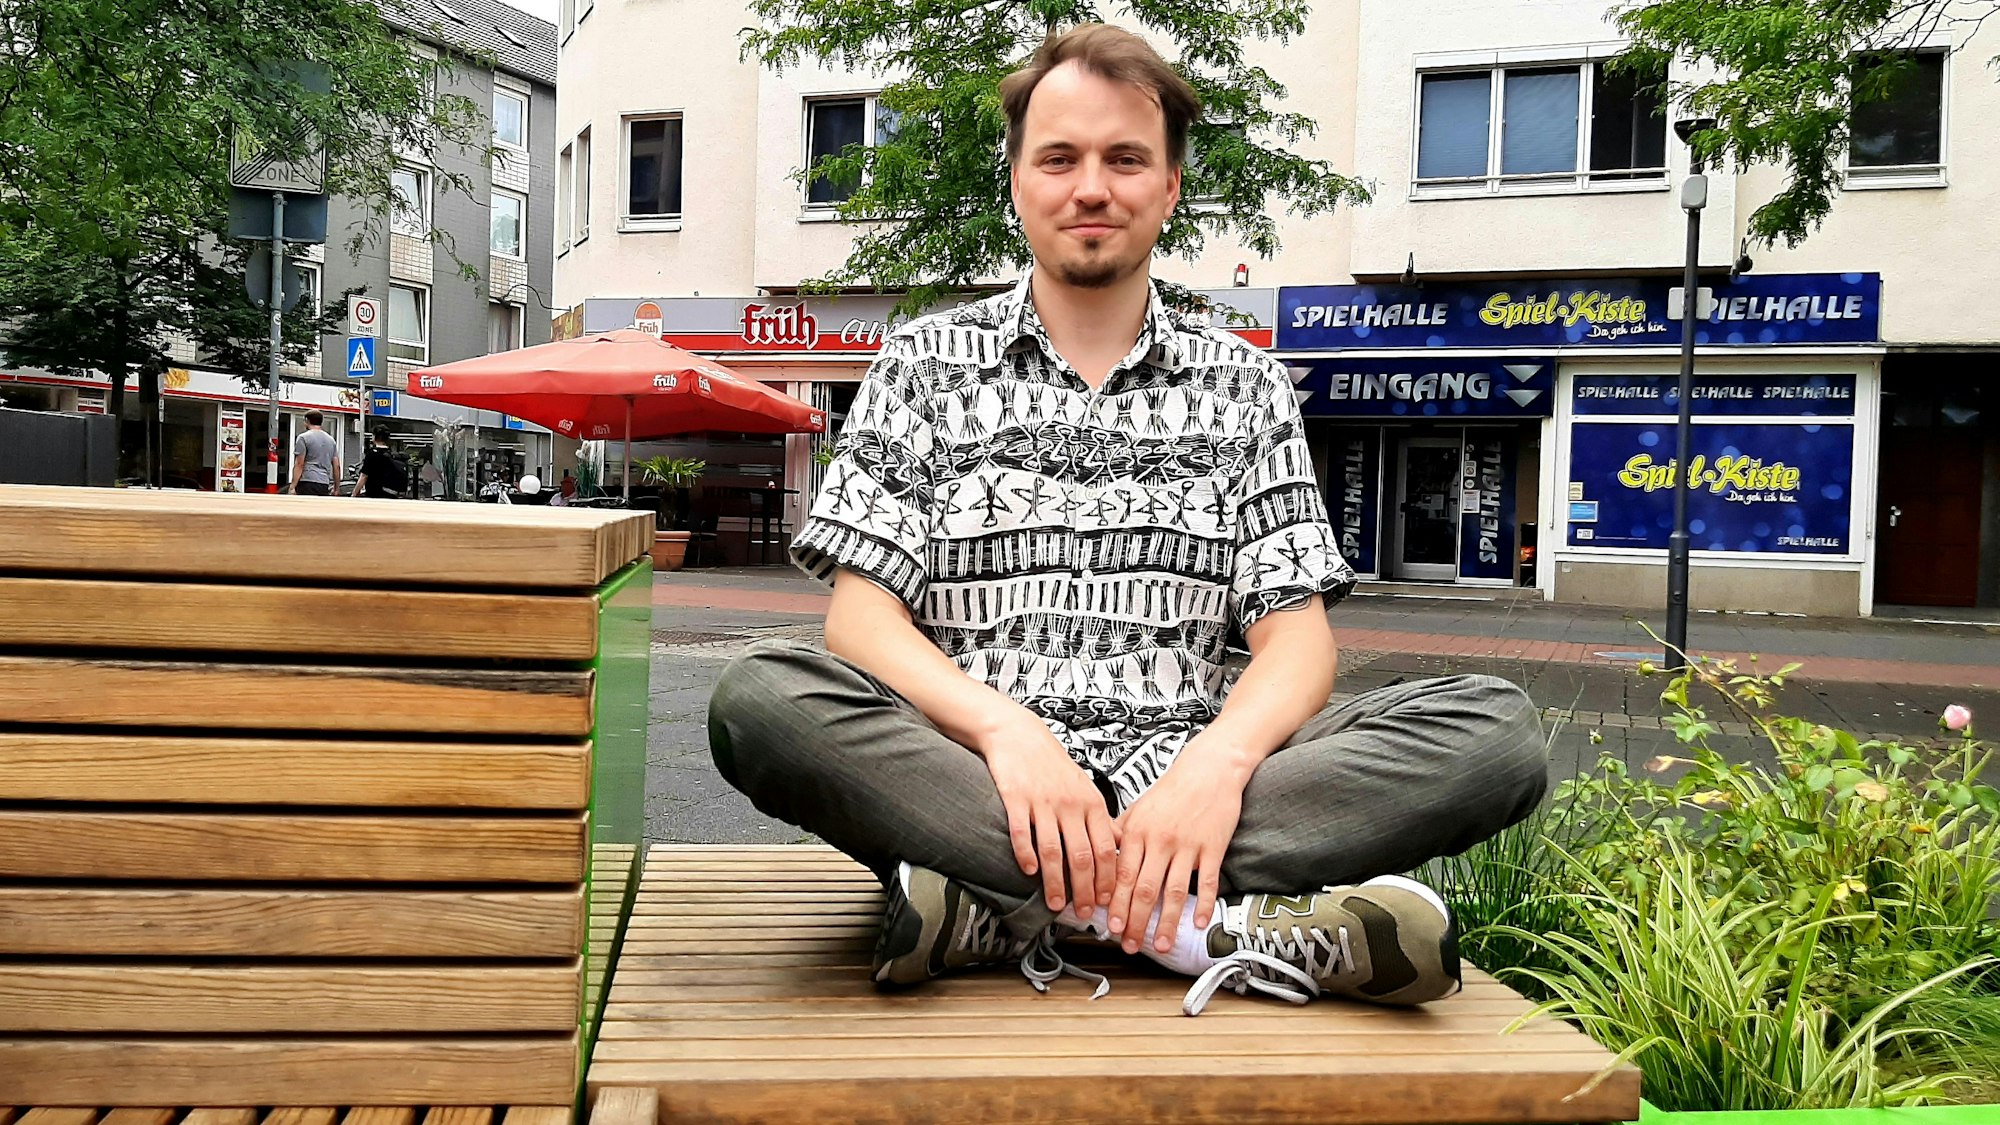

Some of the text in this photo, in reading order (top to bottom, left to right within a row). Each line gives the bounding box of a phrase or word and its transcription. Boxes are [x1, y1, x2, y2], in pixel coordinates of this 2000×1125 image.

[360, 307, 371, 318] 30
[1292, 303, 1449, 329] SPIELHALLE
[1709, 295, 1863, 322] IELHALLE
[357, 325, 374, 334] ZONE
[1586, 325, 1609, 338] Da
[1608, 324, 1629, 340] geh
[1329, 373, 1491, 402] EINGANG
[1578, 386, 1850, 399] SPIELHALLE SELHALLE SPIELHALLE
[1617, 454, 1706, 492] Spil
[1343, 441, 1363, 559] SPIELHALLE
[1479, 441, 1501, 564] SPIELHALLE
[1777, 536, 1840, 547] SPIELHALLE
